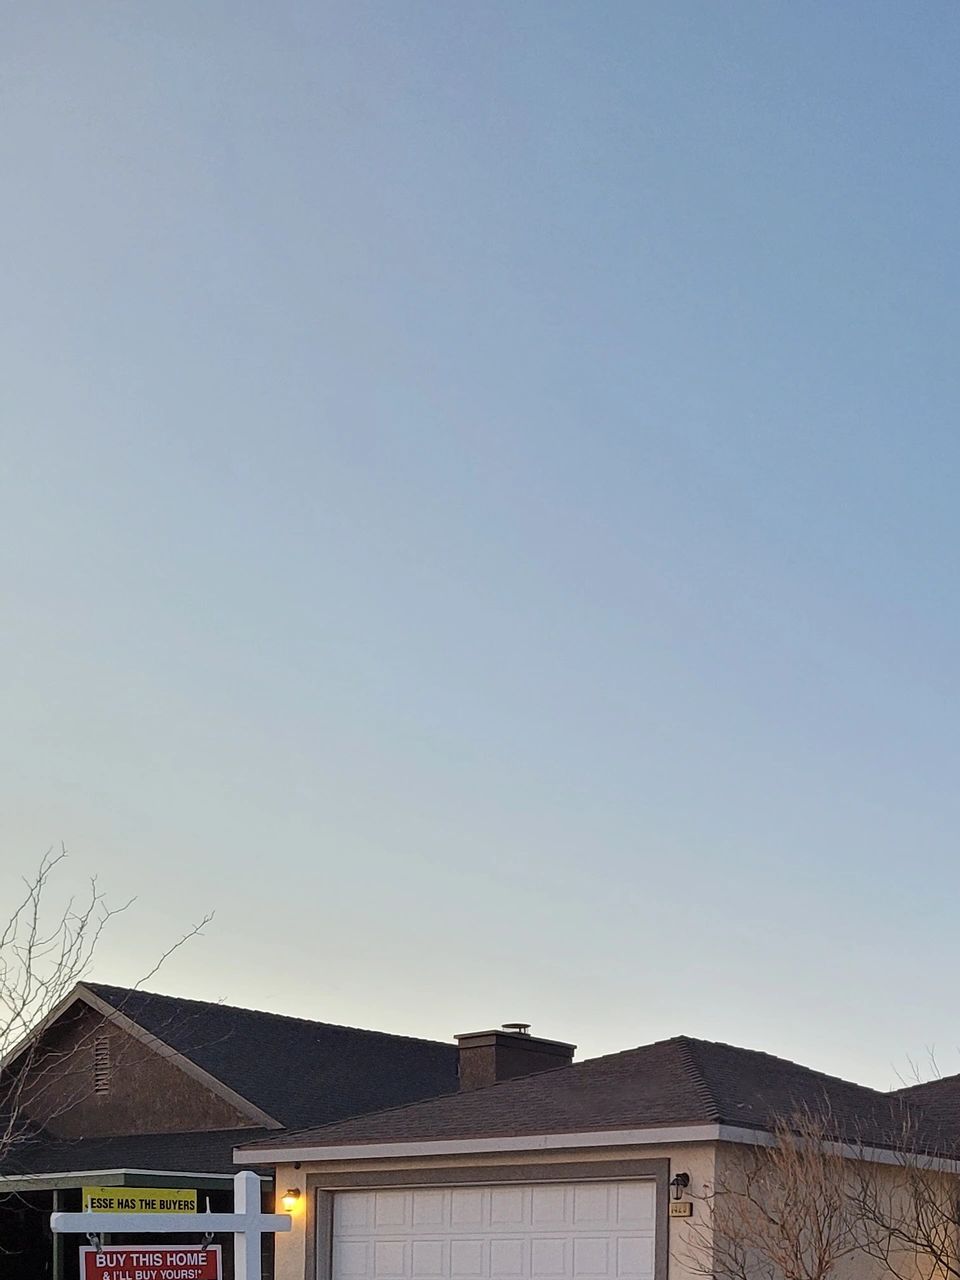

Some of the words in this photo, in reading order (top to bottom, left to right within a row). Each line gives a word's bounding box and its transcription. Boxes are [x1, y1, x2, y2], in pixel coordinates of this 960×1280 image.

[117, 1199, 136, 1209] HAS
[140, 1199, 156, 1210] THE
[159, 1200, 195, 1210] BUYERS
[96, 1254, 126, 1267] BUY
[130, 1253, 163, 1266] THIS
[167, 1253, 207, 1266] HOME
[102, 1271, 111, 1280] &
[113, 1271, 132, 1280] I'LL
[135, 1270, 158, 1280] BUY
